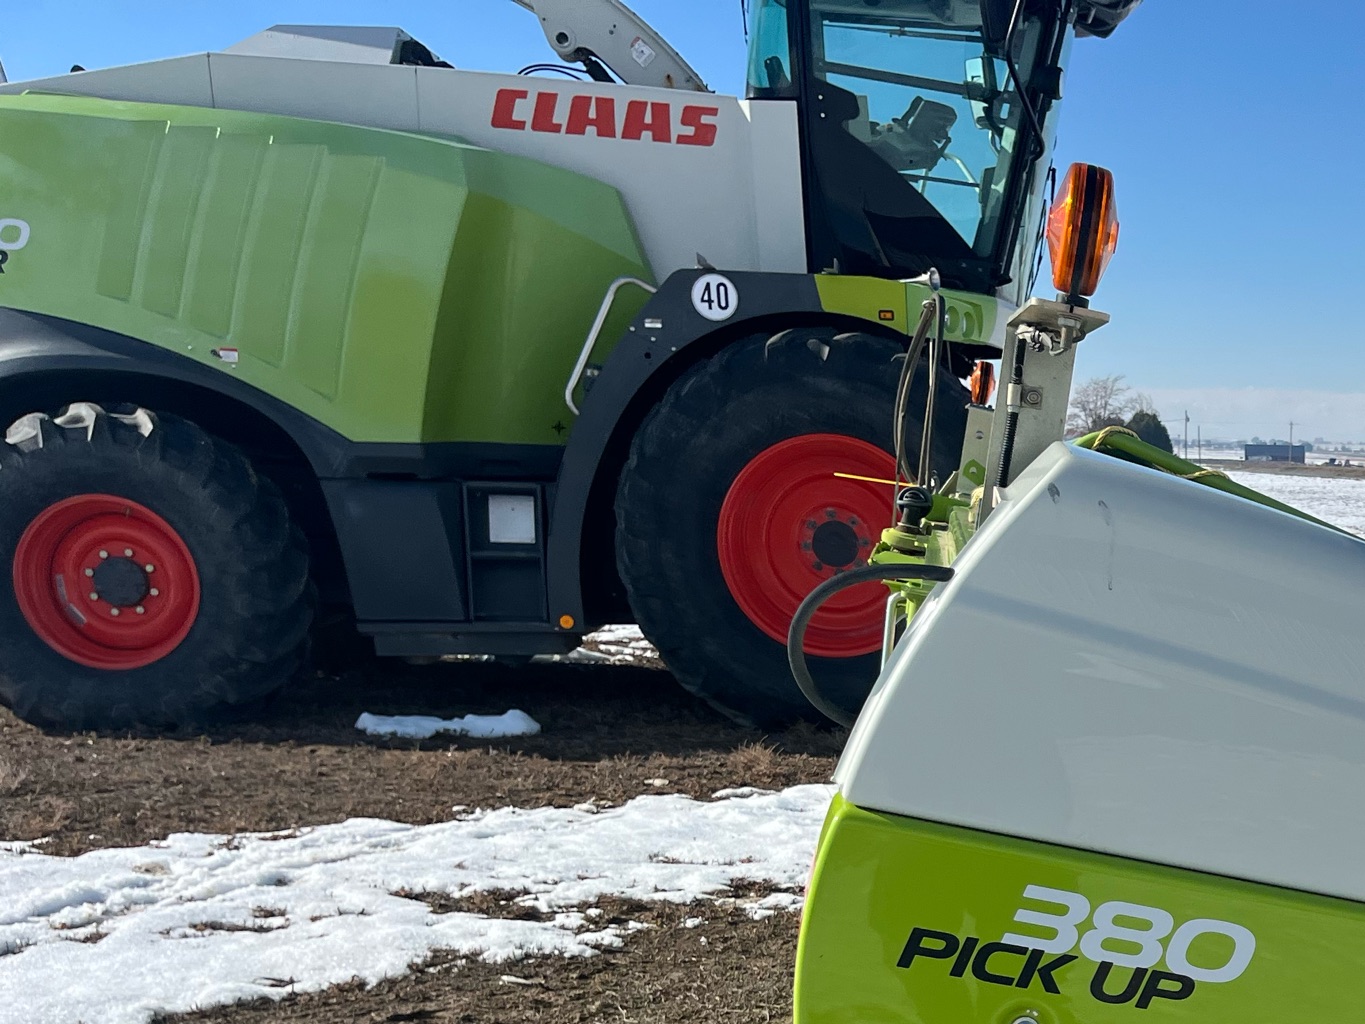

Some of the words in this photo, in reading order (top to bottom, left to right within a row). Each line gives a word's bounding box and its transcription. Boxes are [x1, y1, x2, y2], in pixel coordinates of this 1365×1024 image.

[490, 88, 719, 147] CLAAS
[700, 282, 729, 310] 40
[896, 927, 1079, 994] PICK
[1089, 960, 1196, 1010] UP
[1000, 884, 1257, 983] 380
